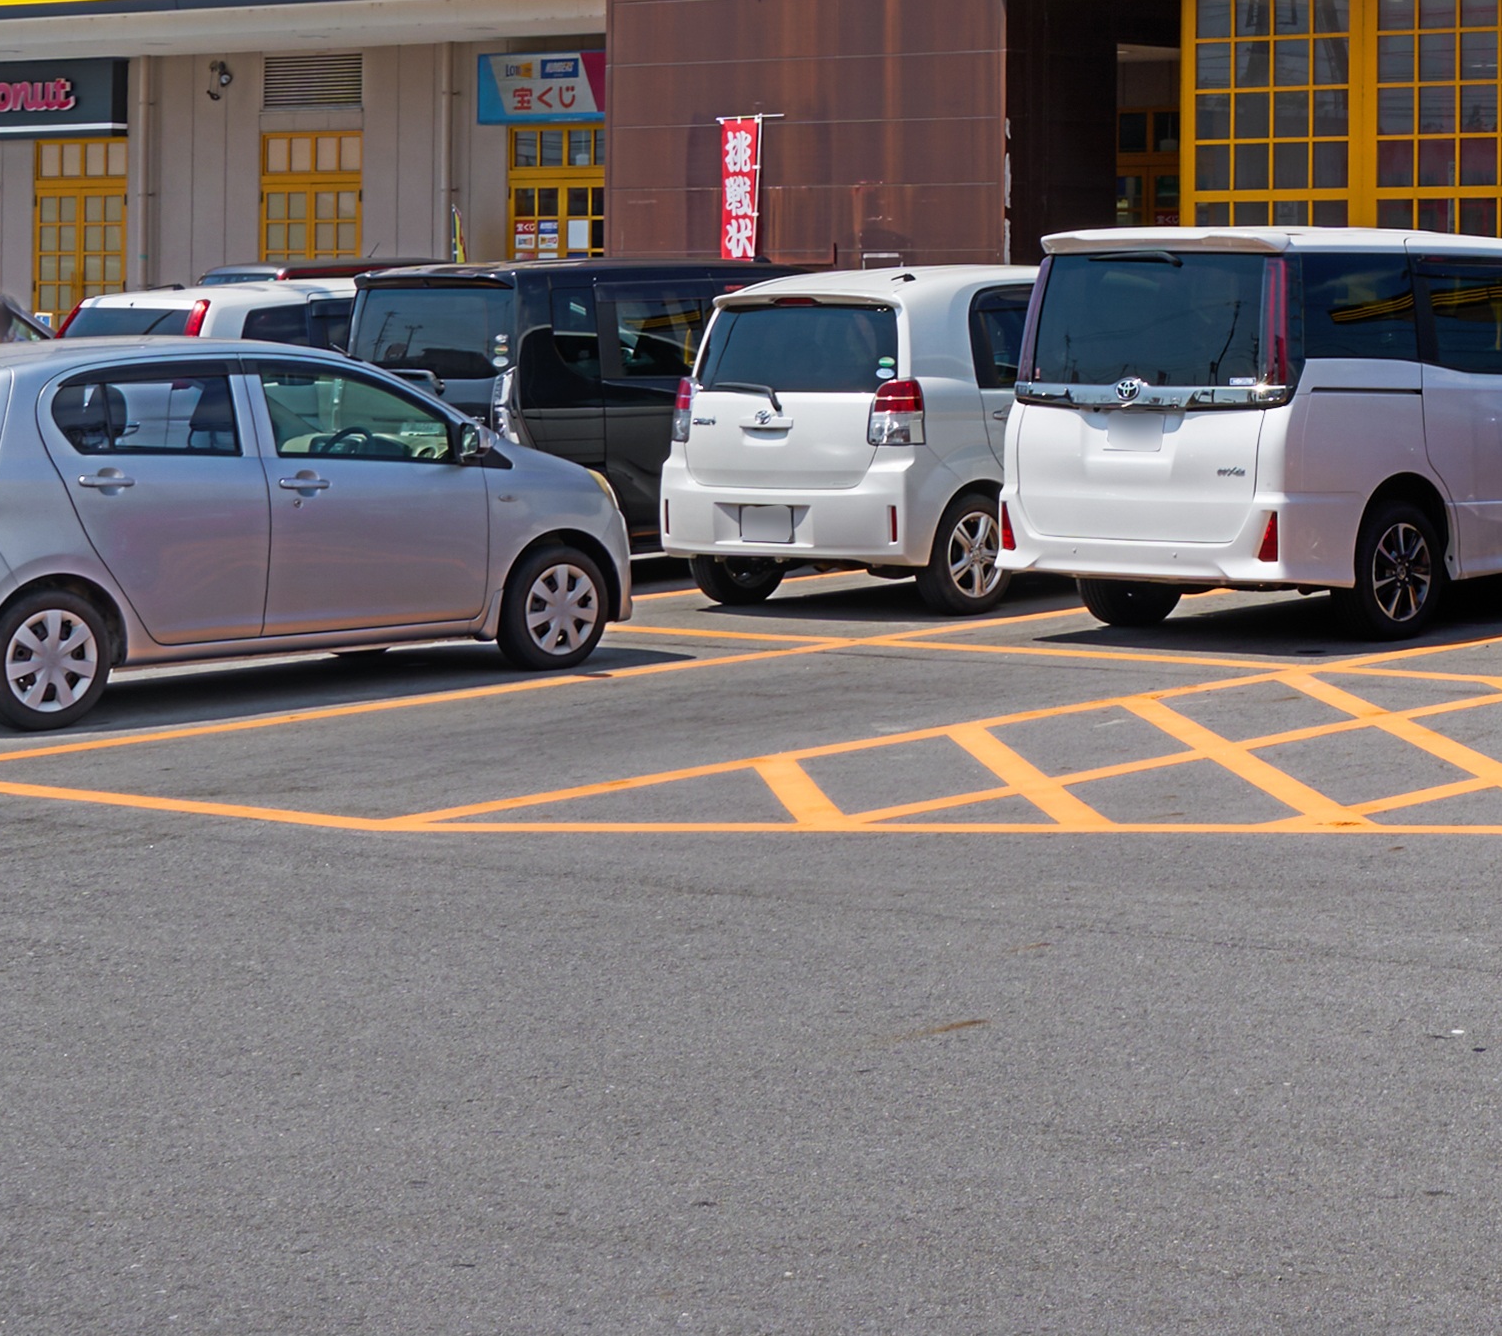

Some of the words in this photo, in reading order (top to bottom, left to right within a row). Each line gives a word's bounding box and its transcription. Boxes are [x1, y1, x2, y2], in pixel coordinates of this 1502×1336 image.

[512, 85, 576, 111] 宝くじ
[724, 130, 753, 258] 挑戦状
